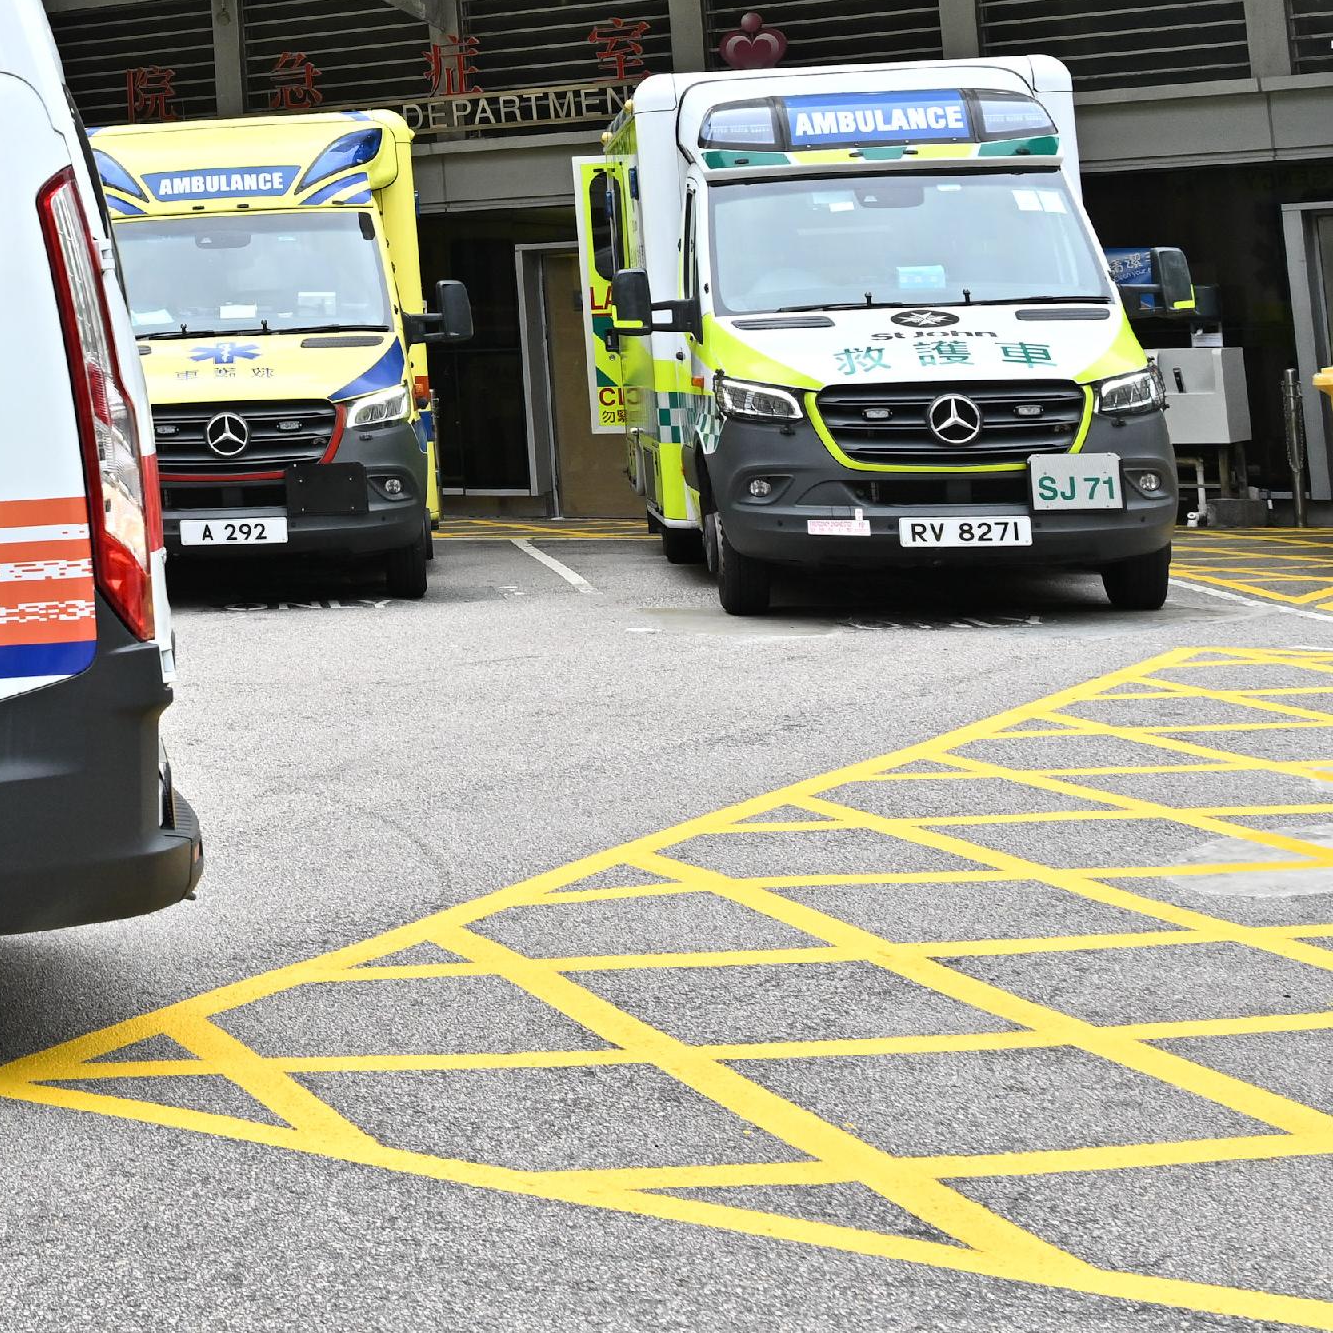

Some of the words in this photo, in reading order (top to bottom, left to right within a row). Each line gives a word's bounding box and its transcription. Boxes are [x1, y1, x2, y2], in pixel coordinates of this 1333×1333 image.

[403, 85, 636, 130] DEPARTMEN
[795, 106, 964, 136] AMBULANCE
[158, 171, 284, 196] AMBULANCE
[871, 331, 906, 341] St
[914, 330, 998, 339] John
[833, 340, 1057, 375] 救護車
[1038, 475, 1076, 501] SJ
[1084, 476, 1115, 500] 71
[202, 525, 214, 541] A
[226, 523, 268, 542] 292
[910, 524, 947, 542] RV
[958, 523, 1020, 543] 8271
